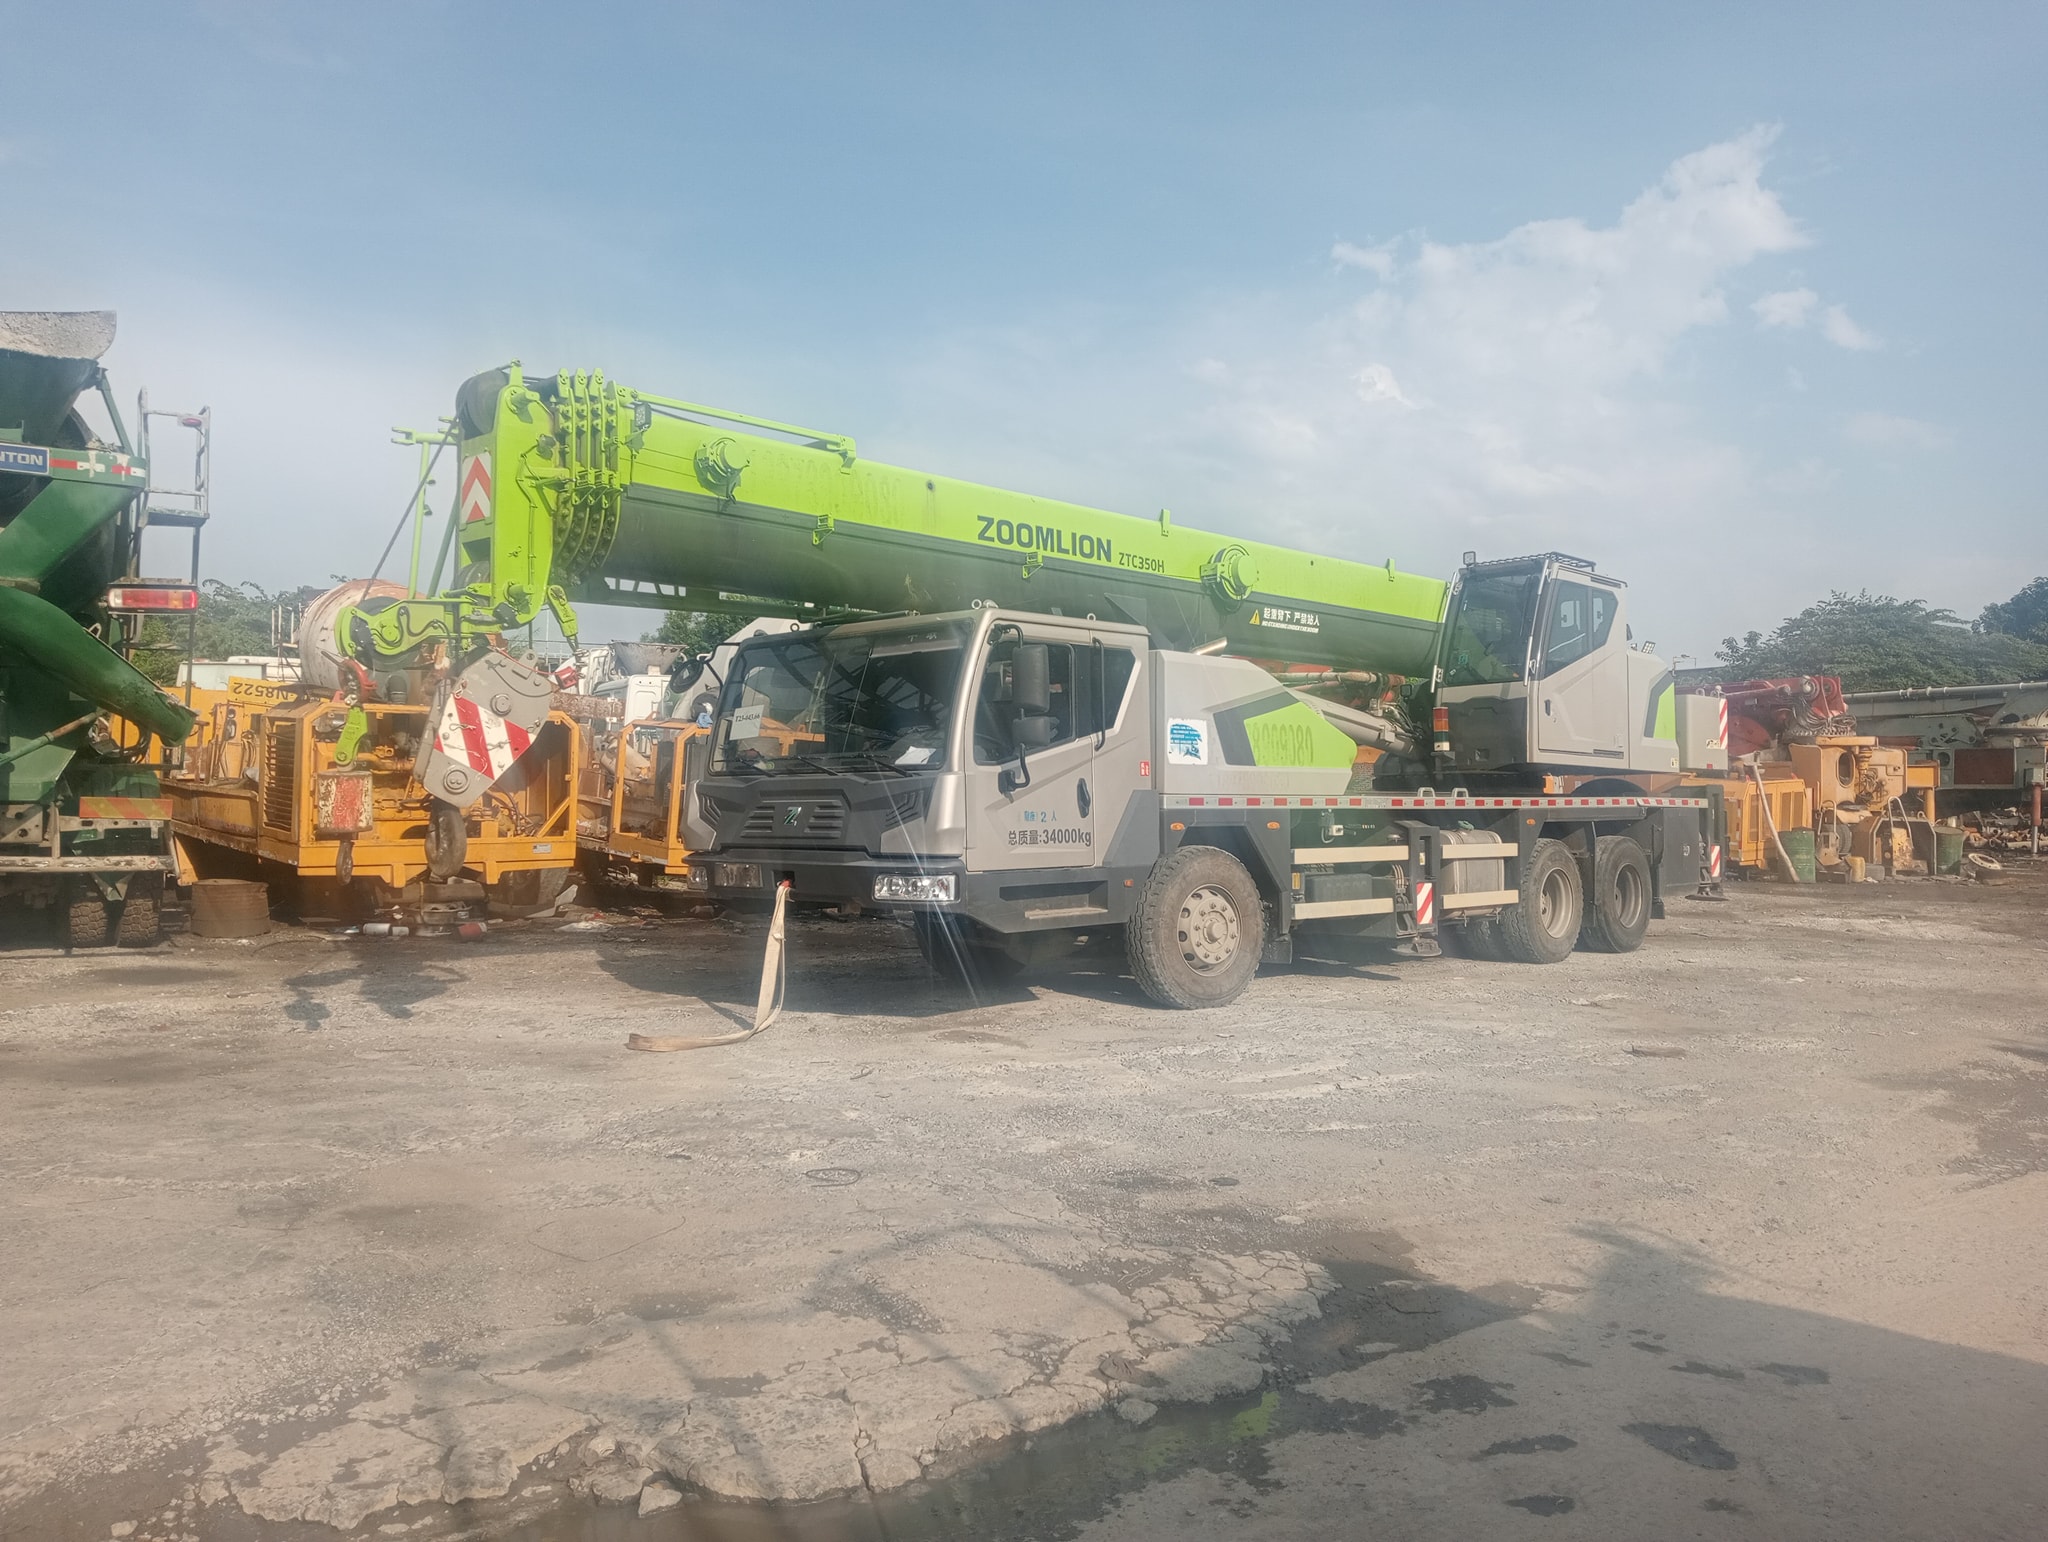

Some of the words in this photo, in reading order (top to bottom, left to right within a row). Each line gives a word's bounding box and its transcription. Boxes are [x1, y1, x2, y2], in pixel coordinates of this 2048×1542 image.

[977, 515, 1112, 563] ZOOMLION
[1118, 552, 1165, 574] ZTC350H
[1008, 828, 1092, 847] 总质量:34000kg
